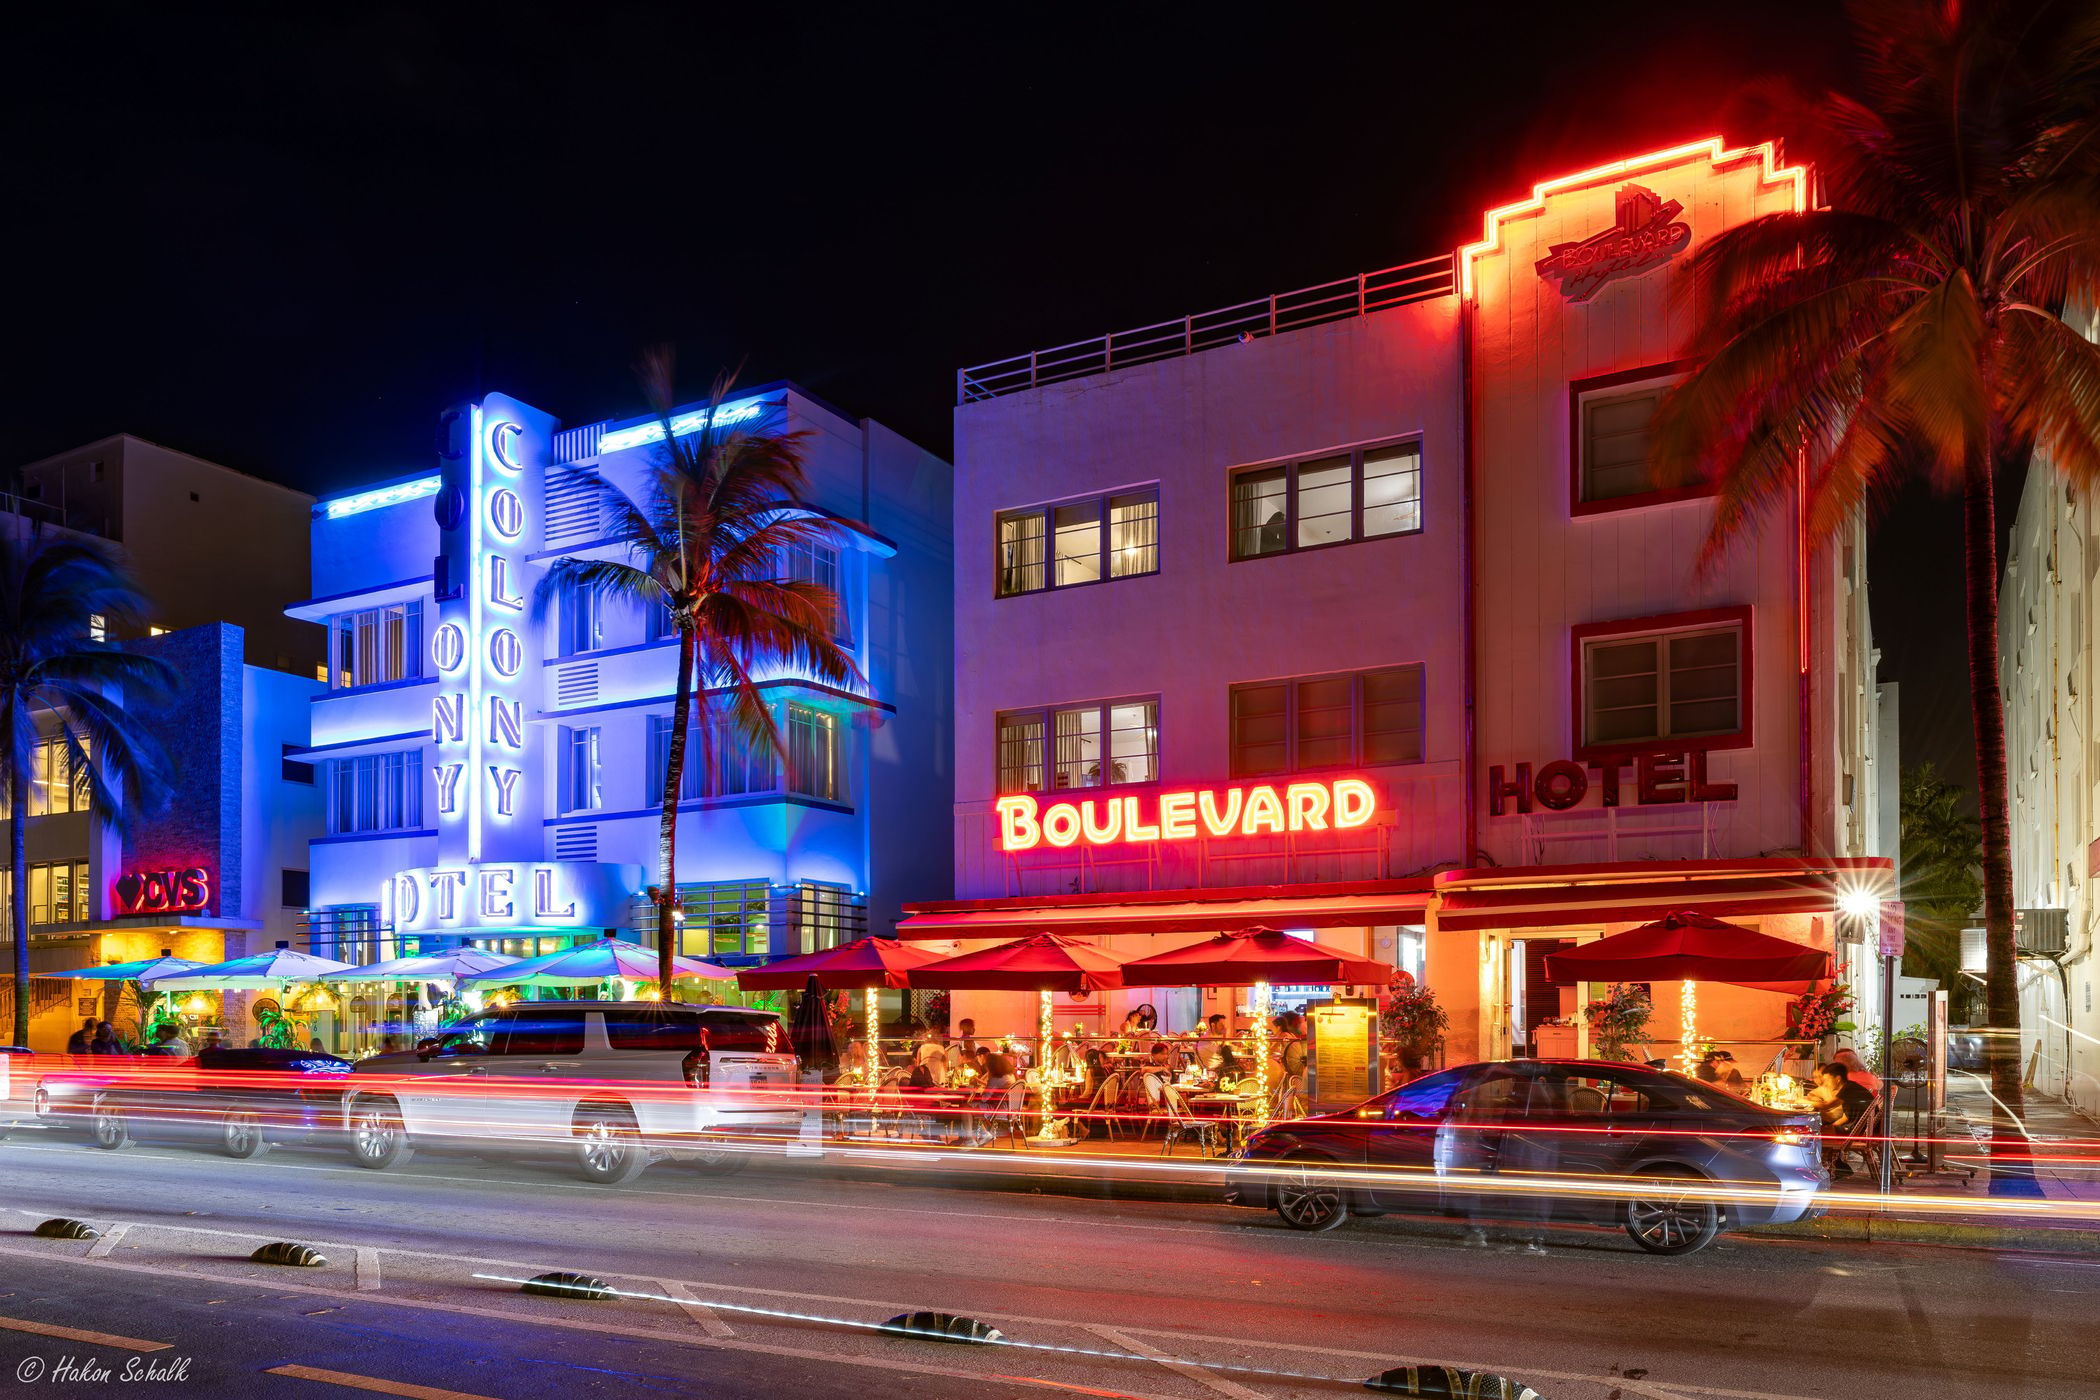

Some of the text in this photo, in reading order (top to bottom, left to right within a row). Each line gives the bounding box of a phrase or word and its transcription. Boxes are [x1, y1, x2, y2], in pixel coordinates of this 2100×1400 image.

[1562, 226, 1685, 268] BOULEVARD
[489, 421, 524, 816] COLONY
[997, 778, 1376, 851] BOULEVARD
[1489, 751, 1739, 816] HOTEL
[144, 868, 208, 909] CVS
